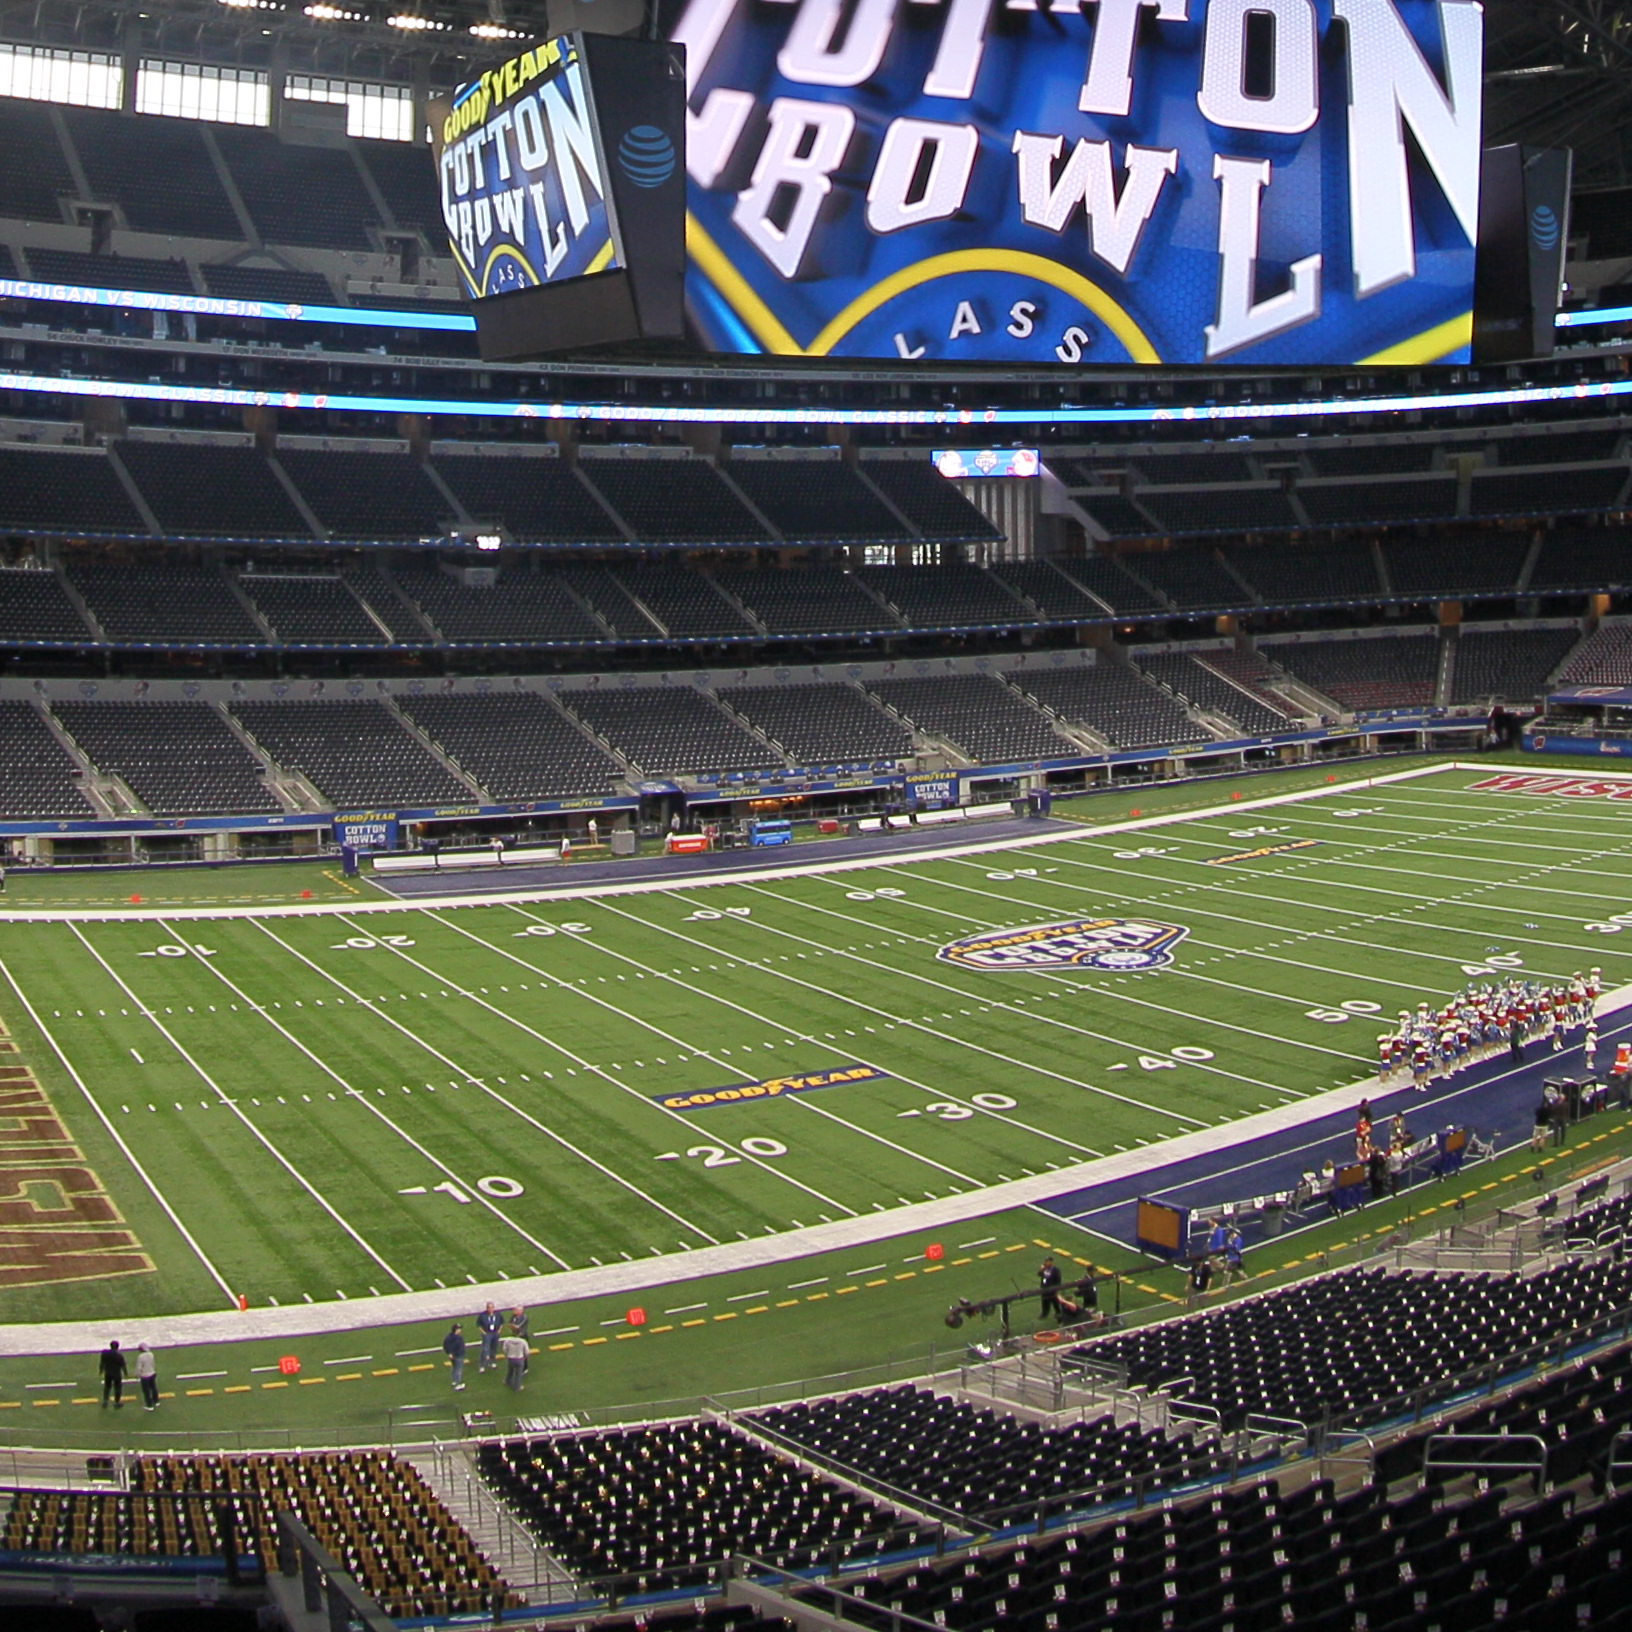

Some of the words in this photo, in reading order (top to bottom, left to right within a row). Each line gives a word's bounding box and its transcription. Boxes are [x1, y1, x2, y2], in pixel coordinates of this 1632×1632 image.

[442, 39, 561, 144] GOODYEAR
[441, 63, 604, 238] COTTON
[458, 181, 569, 278] BOWL
[730, 97, 1323, 360] BOWL
[105, 290, 134, 308] VS
[142, 292, 263, 318] WISCONSIN
[90, 379, 151, 399] BOWL
[159, 385, 248, 405] CLASSIC
[600, 406, 706, 422] GOODYEAR
[714, 408, 787, 422] COTTON
[796, 410, 842, 423] BOWL
[852, 410, 926, 423] CLASSIC
[1224, 401, 1326, 418] GOODYEAR
[905, 770, 958, 783] GOODYEAR
[915, 782, 950, 793] COTTON
[333, 810, 397, 823] GOODYEAR
[344, 823, 387, 836] COTTON
[345, 834, 377, 845] BOWL
[1205, 838, 1320, 867] GOODYEAR
[1112, 847, 1164, 860] 30
[986, 866, 1039, 881] 40
[845, 886, 906, 901] 50
[697, 905, 753, 922] 40
[1582, 911, 1629, 935] 30
[349, 933, 416, 950] 20
[526, 921, 593, 938] 30
[949, 920, 1119, 953] GOODYEAR
[157, 943, 218, 959] 10
[964, 923, 1164, 964] COTTON
[1021, 935, 1147, 962] BOWL
[1460, 950, 1510, 978] 40
[1303, 998, 1385, 1025] 50
[1135, 1045, 1216, 1072] 40
[924, 1091, 1018, 1121] 30
[684, 1137, 789, 1169] 20
[426, 1174, 525, 1205] 10
